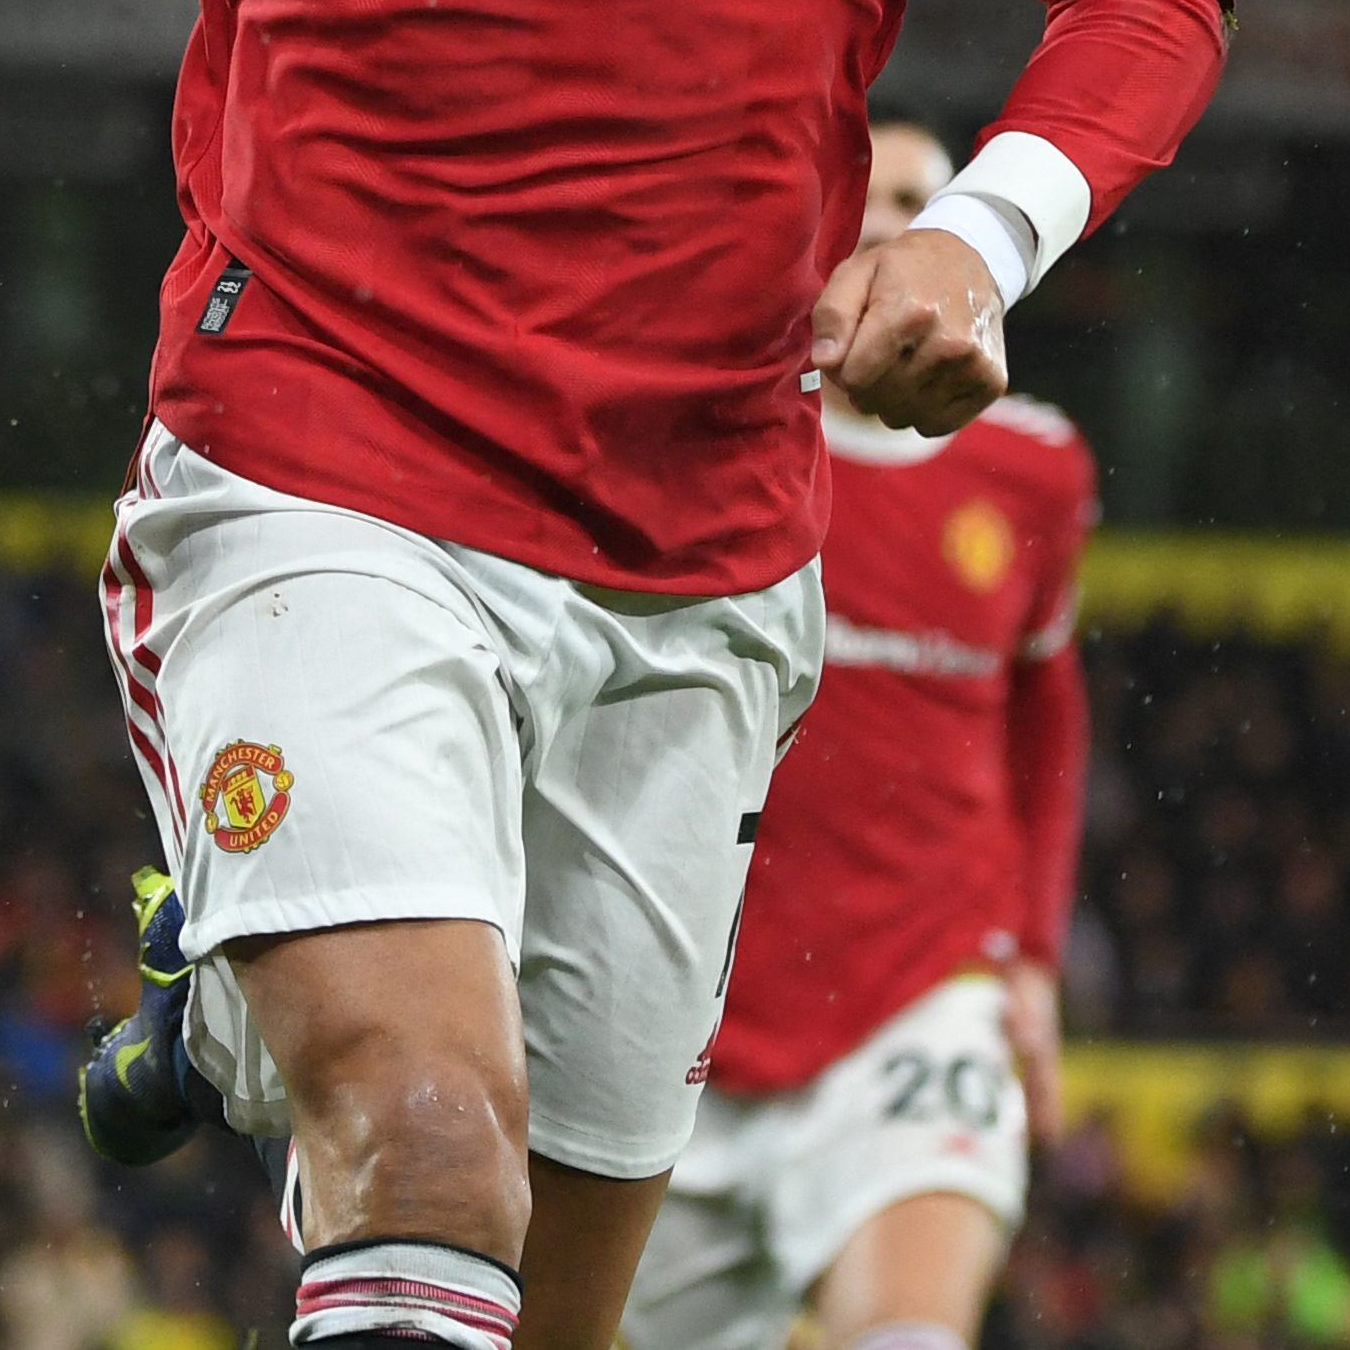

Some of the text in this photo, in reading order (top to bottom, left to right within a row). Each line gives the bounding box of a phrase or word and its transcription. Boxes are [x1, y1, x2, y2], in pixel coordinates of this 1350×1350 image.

[205, 746, 280, 848] MANCHESTER UNITED
[881, 1050, 1004, 1130] 20
